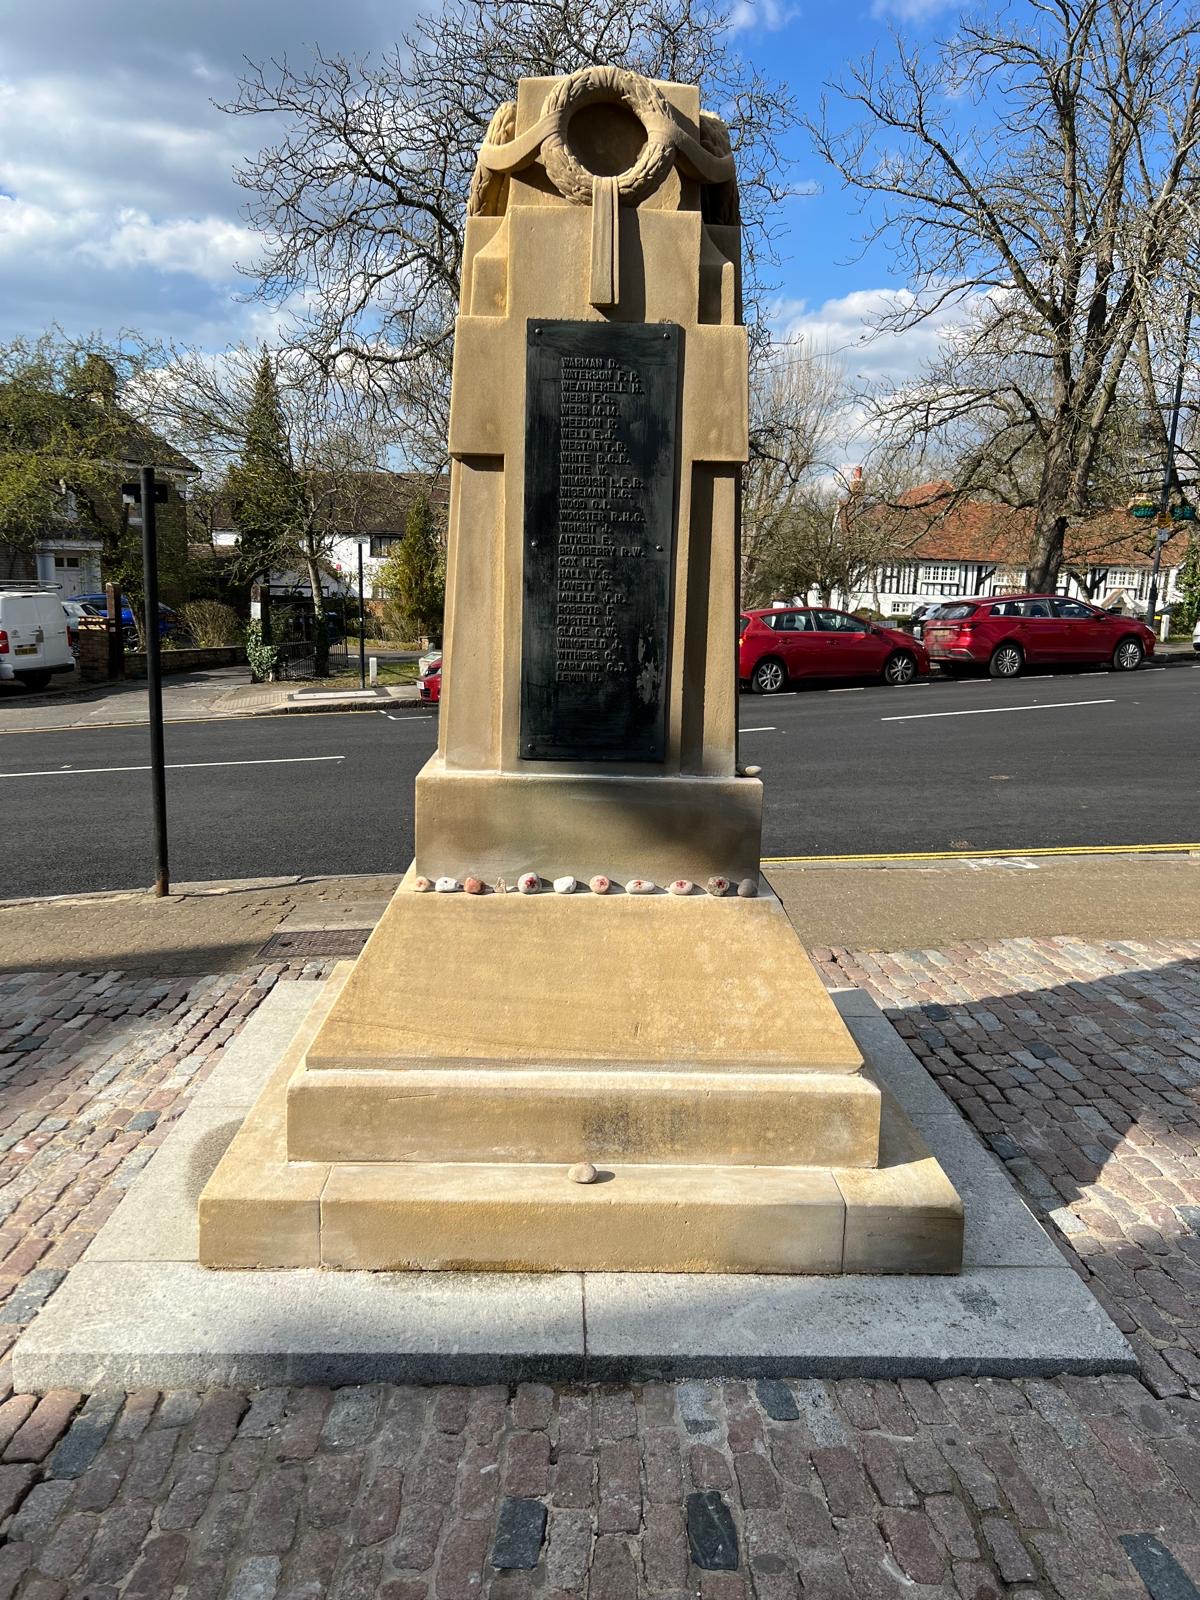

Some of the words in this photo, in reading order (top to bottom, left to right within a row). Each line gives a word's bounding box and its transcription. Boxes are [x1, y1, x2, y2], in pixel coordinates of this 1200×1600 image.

[561, 368, 612, 380] WATERSON
[561, 380, 627, 392] WEATHERELL
[561, 392, 589, 403] WEBB
[560, 404, 588, 414] WEBB
[560, 416, 601, 427] WEEDON
[560, 428, 588, 439] WELD
[560, 440, 600, 451] WESTON
[560, 452, 591, 463] WHITE
[560, 463, 591, 474] WHITE
[560, 475, 606, 487] WIMBUSH
[560, 487, 606, 498] WISEMAN
[559, 498, 585, 509] WOOD
[559, 510, 604, 521] WOOSTER
[559, 521, 597, 532] WRIGHT
[559, 533, 595, 544] AITKEN
[558, 545, 615, 556] BRADBERRY
[558, 556, 578, 567] COX
[558, 568, 583, 579] HALL
[557, 580, 595, 591] LOVETT
[557, 592, 596, 602] MULLER
[557, 604, 601, 615] ROBERTS
[557, 626, 589, 636] SLADE
[556, 637, 606, 649] WINGFIELD
[556, 650, 599, 660] WITHERS
[556, 661, 600, 671] GARLAND
